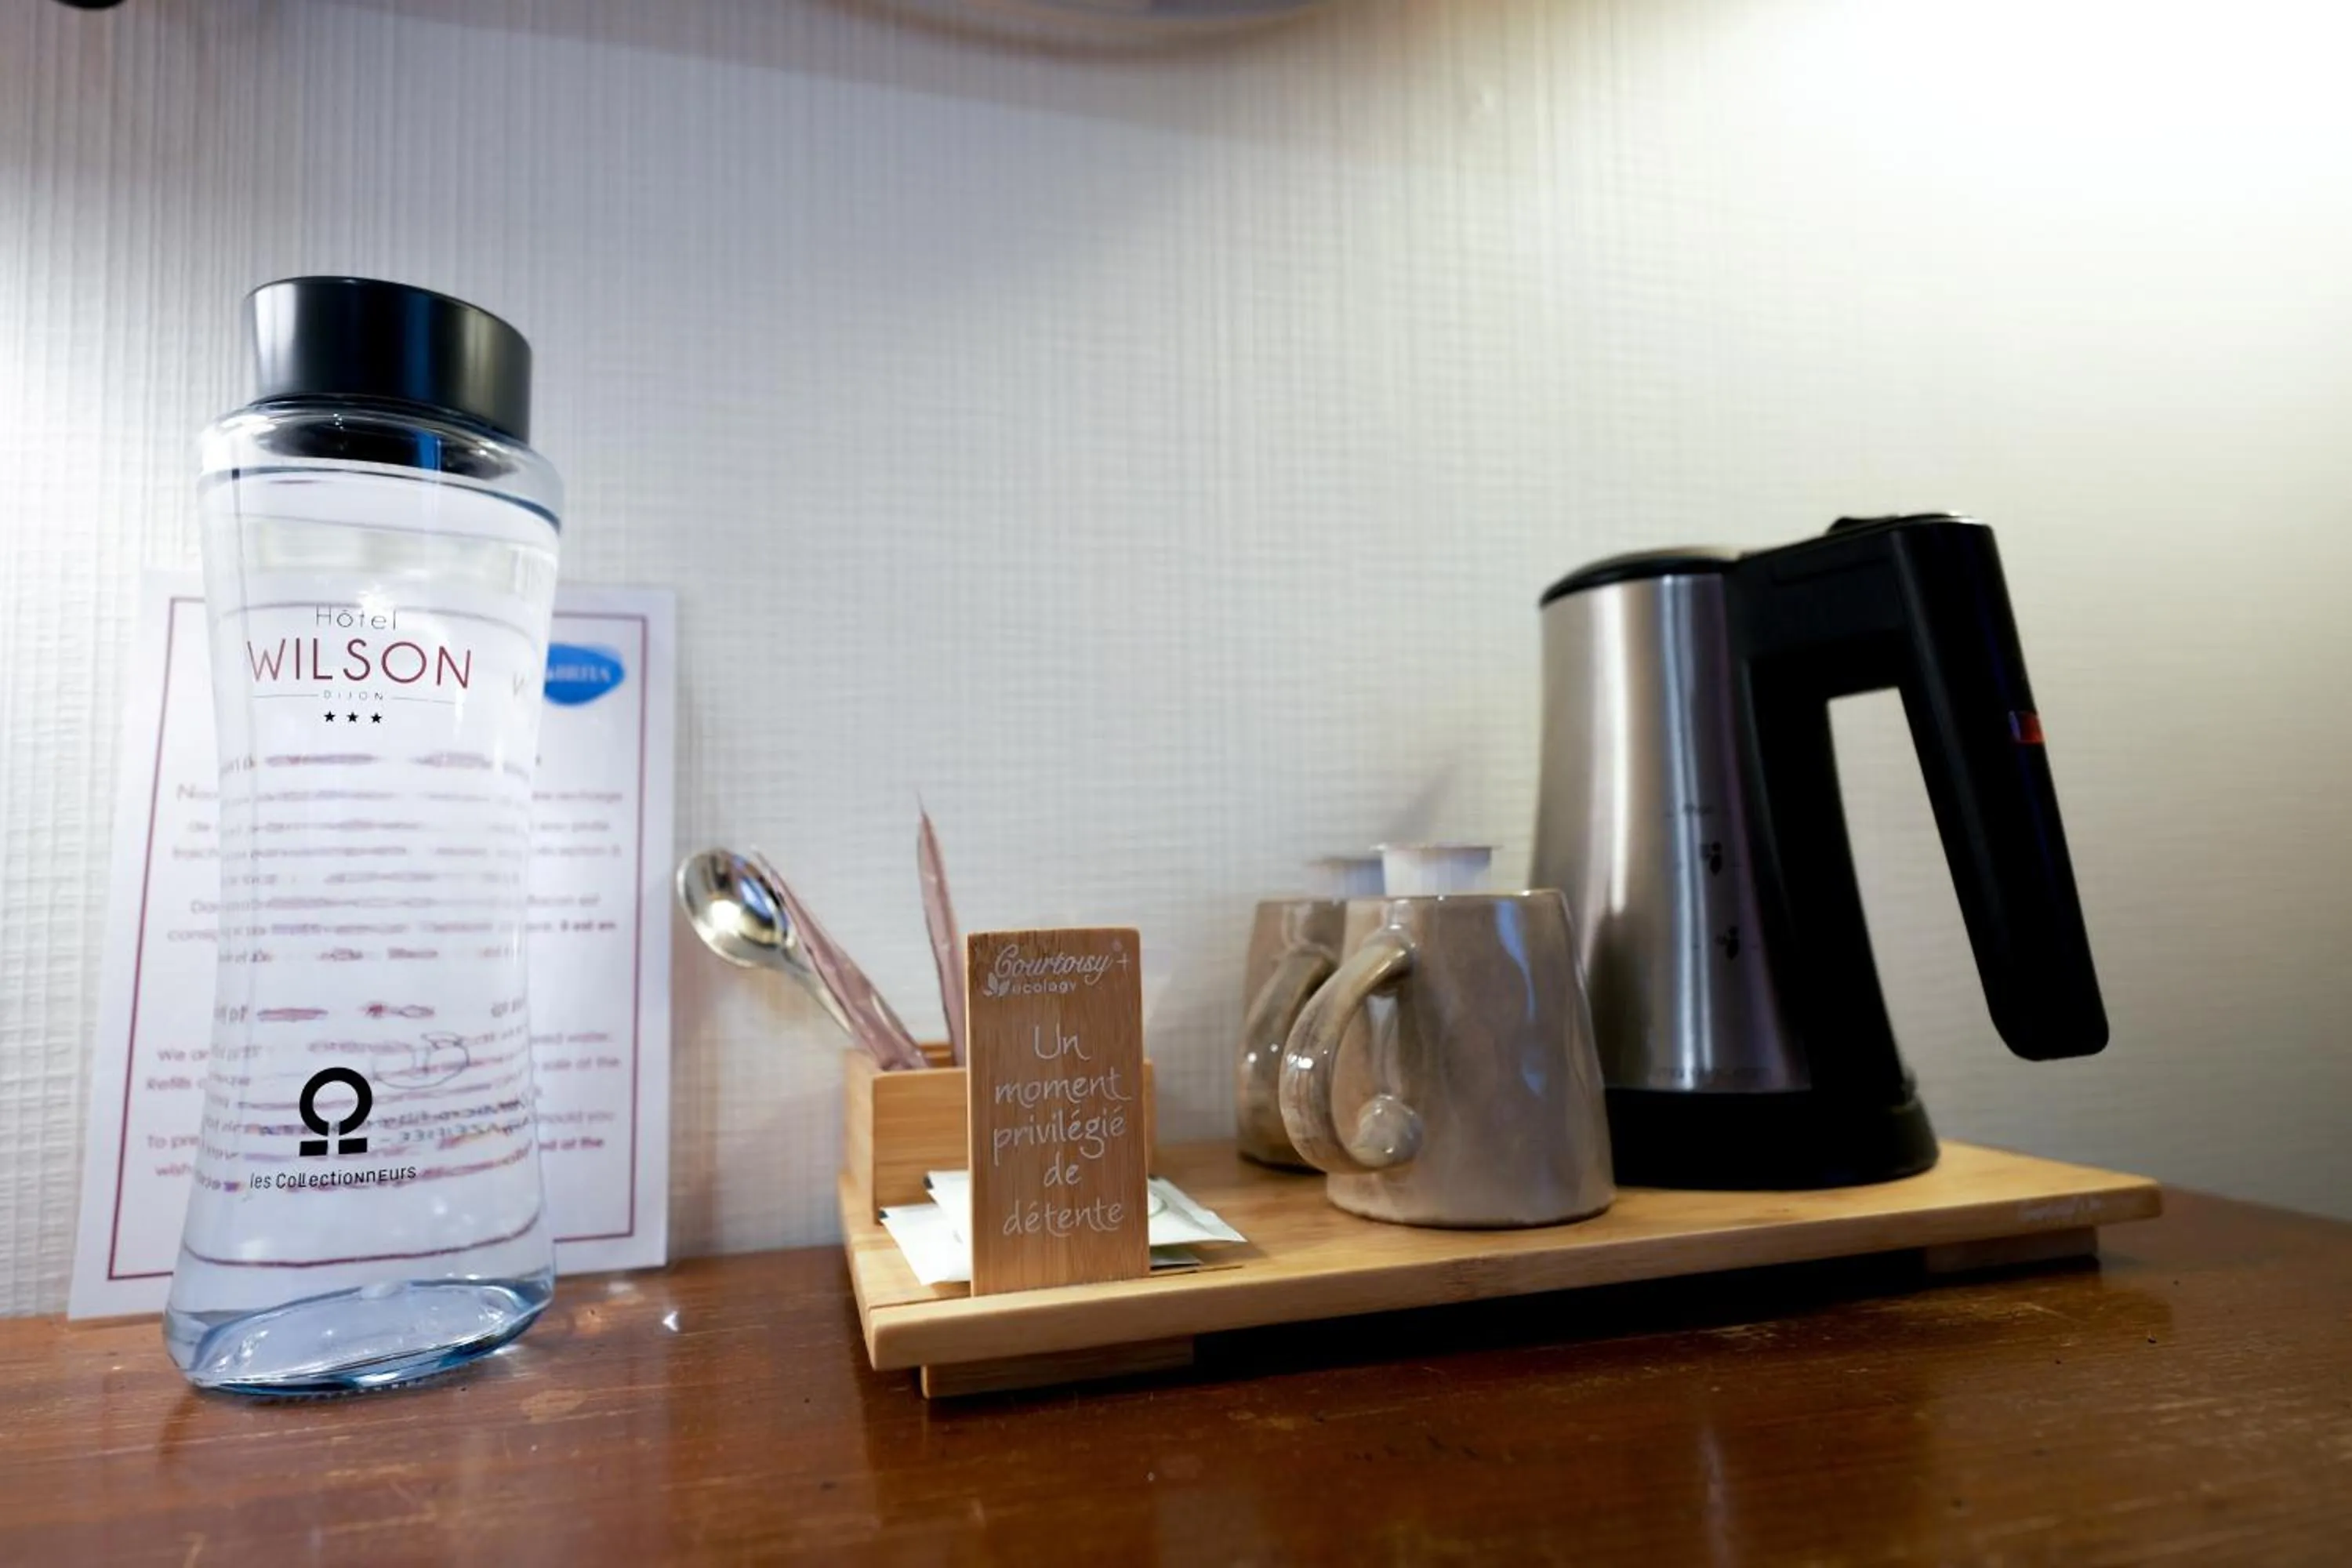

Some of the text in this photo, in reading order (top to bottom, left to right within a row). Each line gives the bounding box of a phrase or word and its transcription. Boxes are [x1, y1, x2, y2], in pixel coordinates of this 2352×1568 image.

[315, 603, 397, 630] Hôtel
[247, 637, 471, 690] WILSON
[323, 689, 384, 702] DIJON
[1033, 1022, 1092, 1062] Un
[994, 1065, 1133, 1109] moment
[993, 1105, 1127, 1167] privilégié
[249, 1171, 272, 1190] les
[1043, 1150, 1083, 1188] de
[1001, 1196, 1125, 1238] détente
